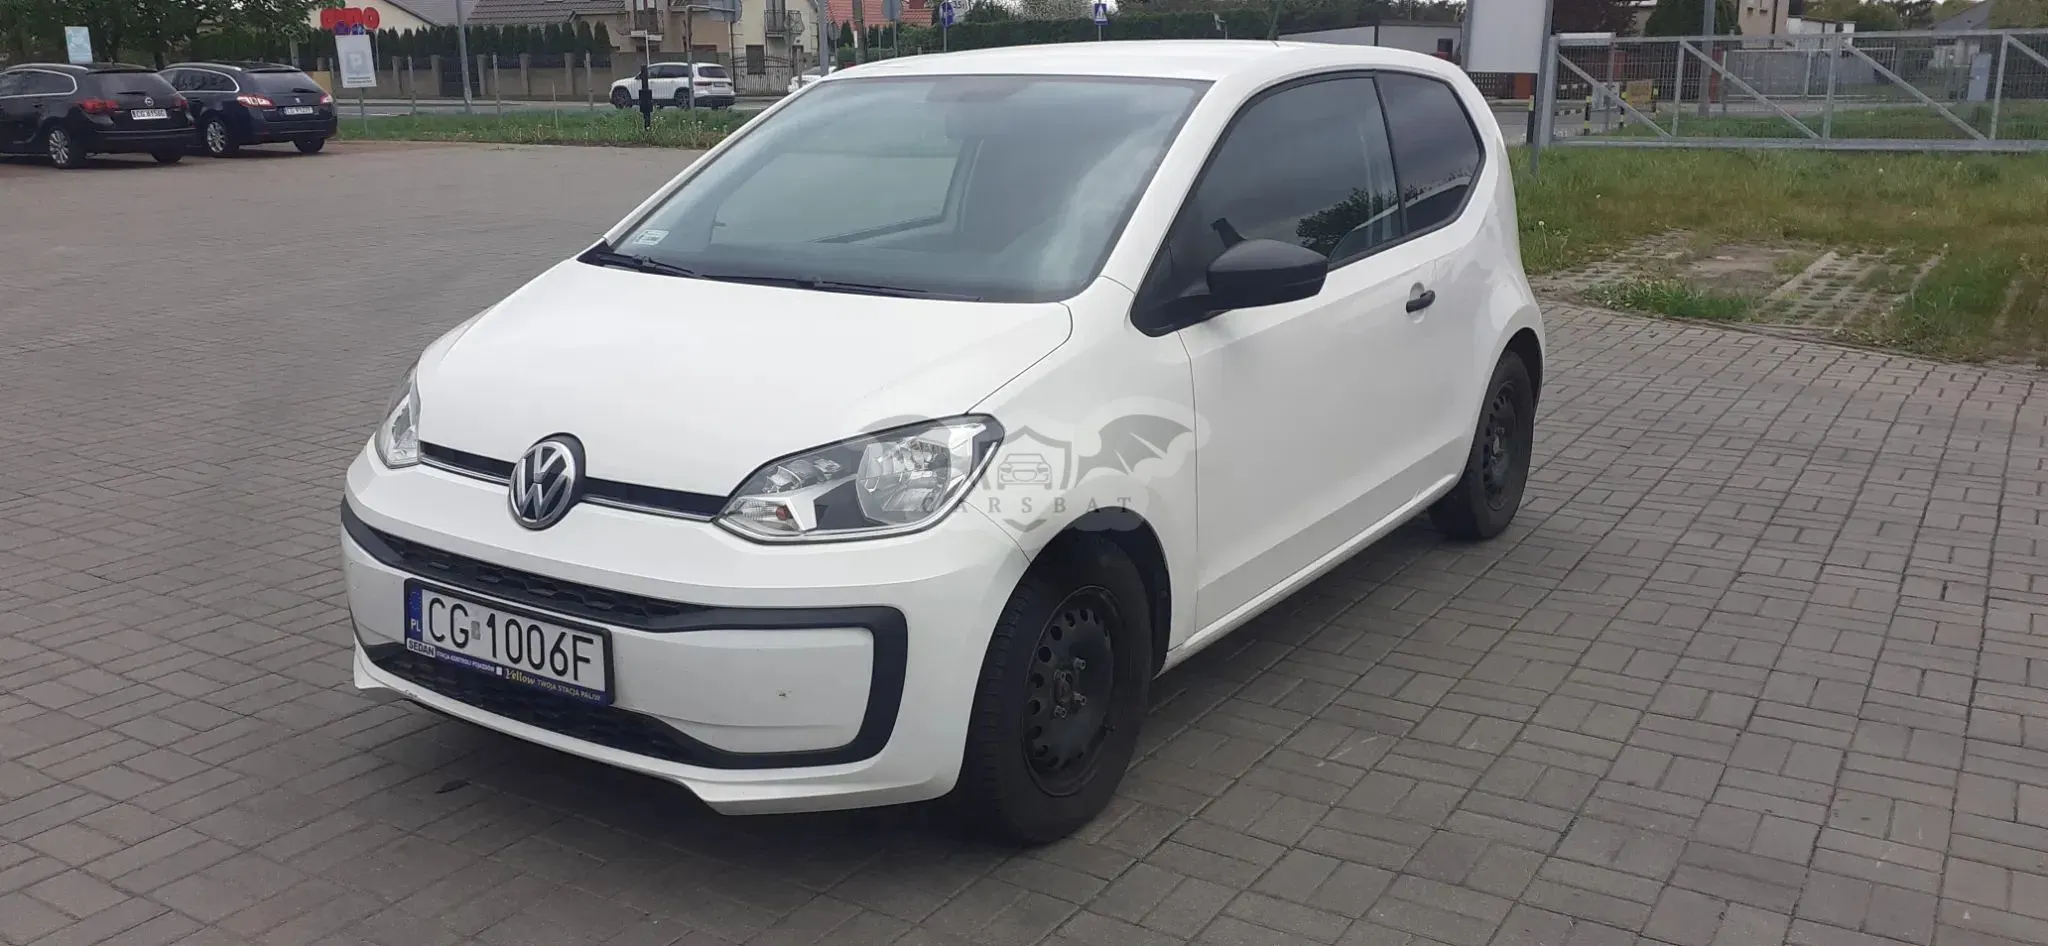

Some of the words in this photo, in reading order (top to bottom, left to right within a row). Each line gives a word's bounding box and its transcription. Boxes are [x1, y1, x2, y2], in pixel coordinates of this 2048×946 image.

[410, 618, 421, 633] PL
[428, 597, 470, 649] CG
[486, 613, 594, 682] 1006F
[408, 640, 434, 656] SEDAN
[505, 668, 536, 685] Yellow
[537, 679, 557, 691] TWOJA
[558, 685, 580, 697] STACJA
